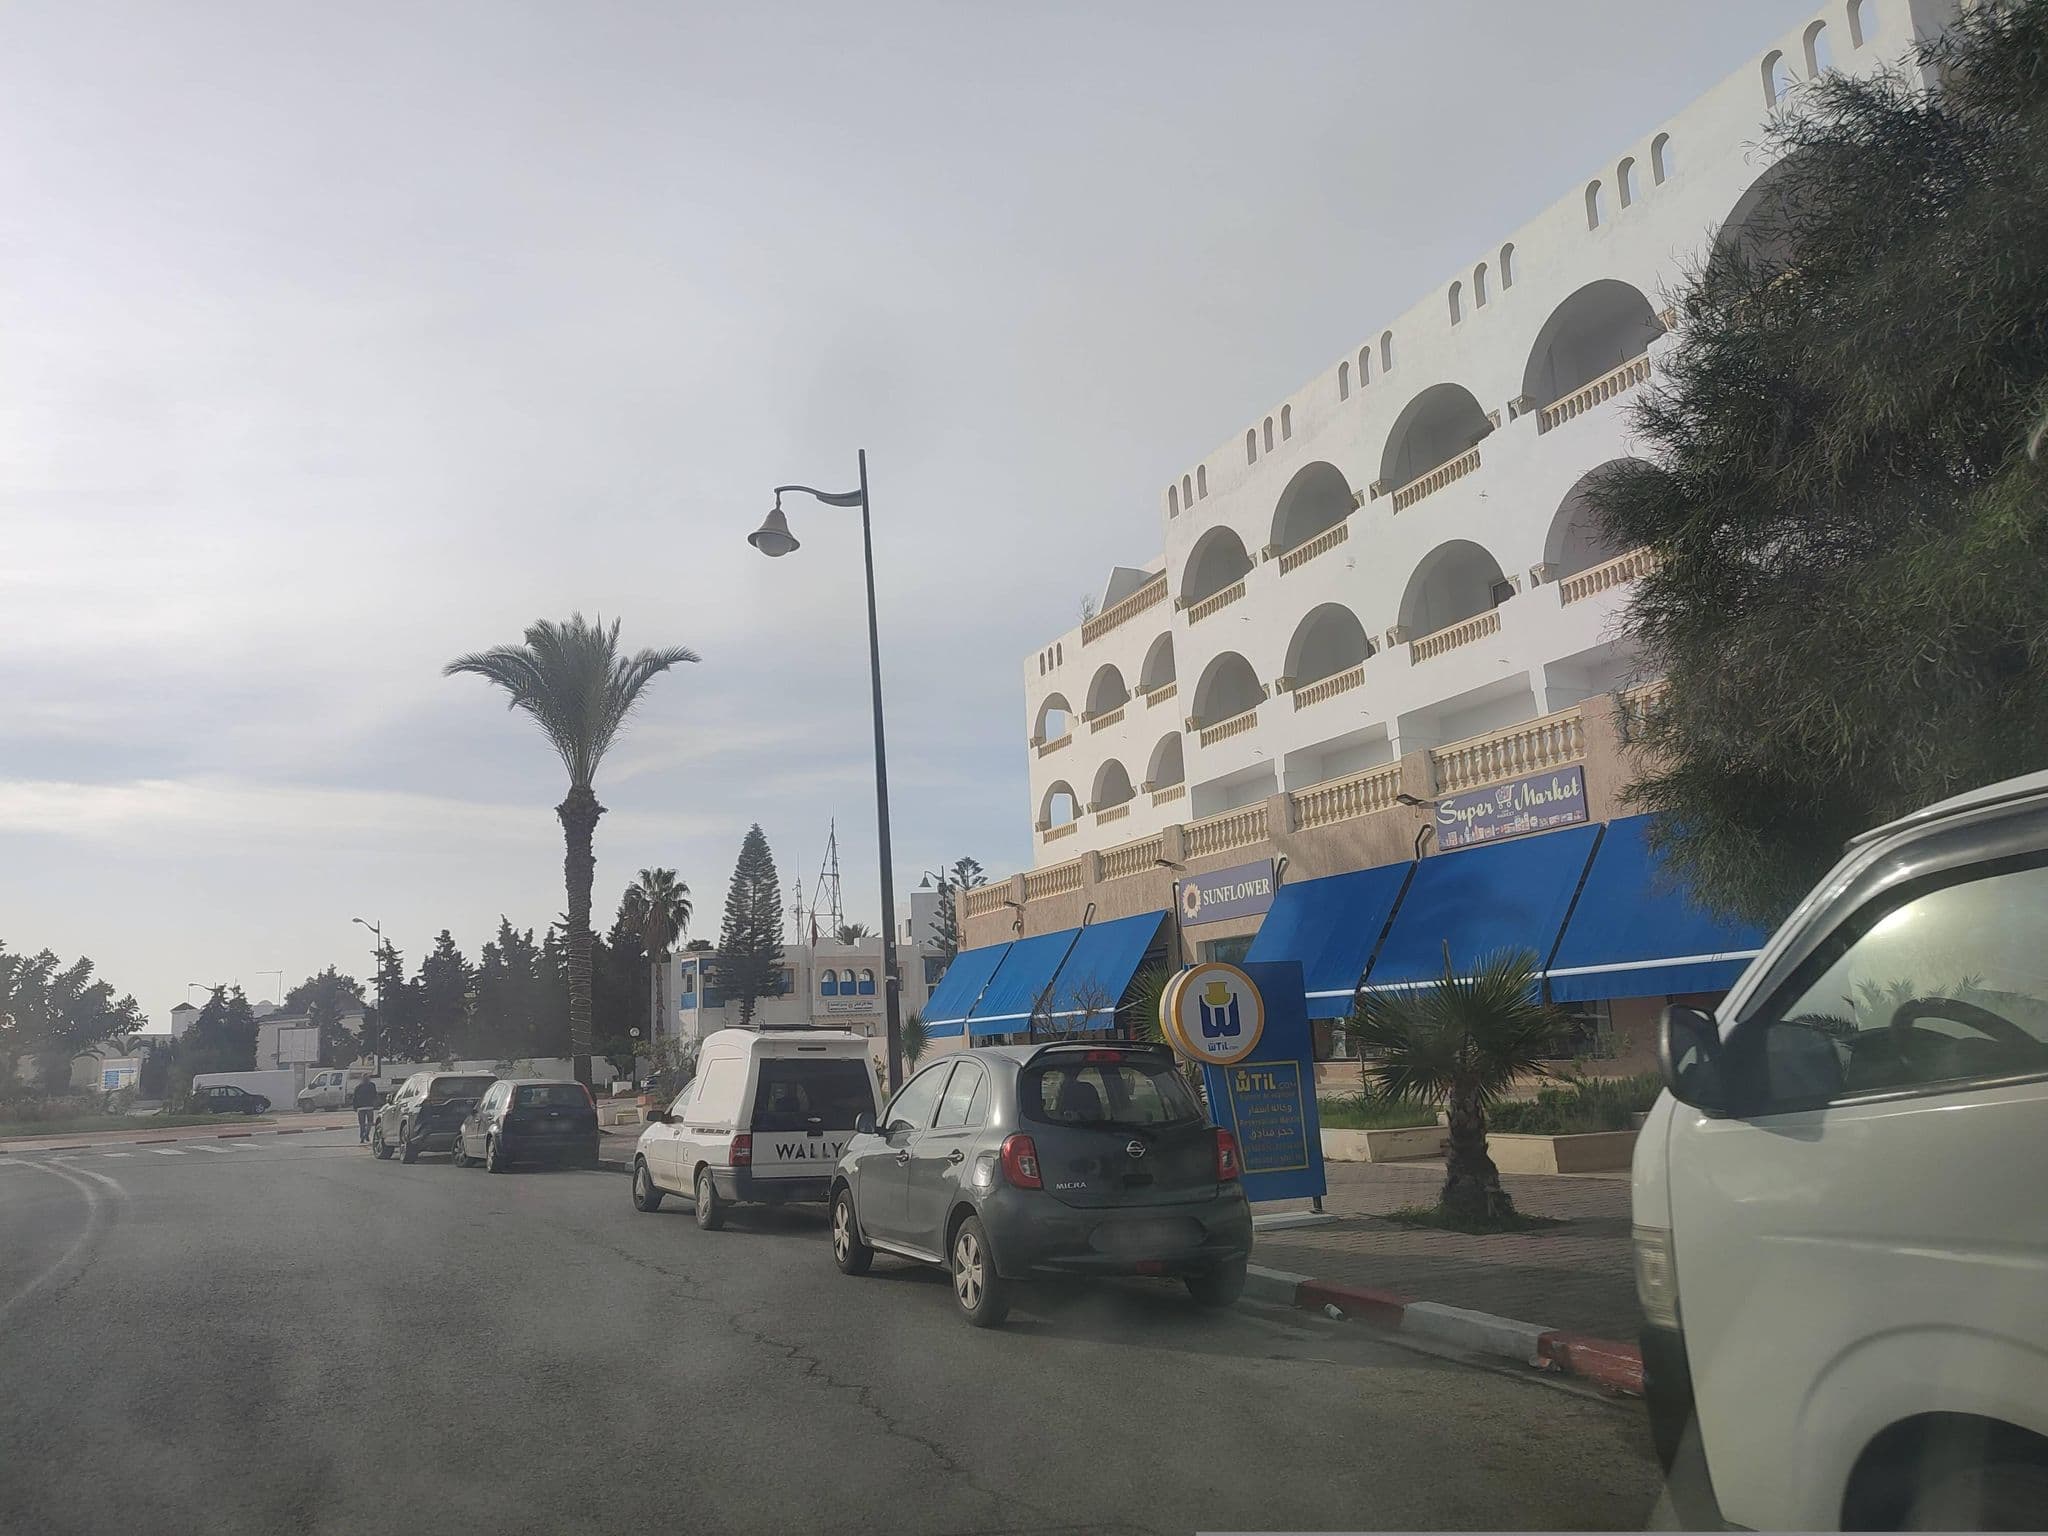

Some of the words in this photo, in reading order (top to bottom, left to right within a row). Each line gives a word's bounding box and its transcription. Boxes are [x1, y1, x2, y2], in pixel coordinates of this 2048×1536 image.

[1437, 800, 1494, 827] Super
[1515, 776, 1580, 811] Market
[1203, 878, 1270, 906] SUNFLOWER
[776, 1142, 844, 1161] WALLY
[1055, 1181, 1087, 1191] MICRA
